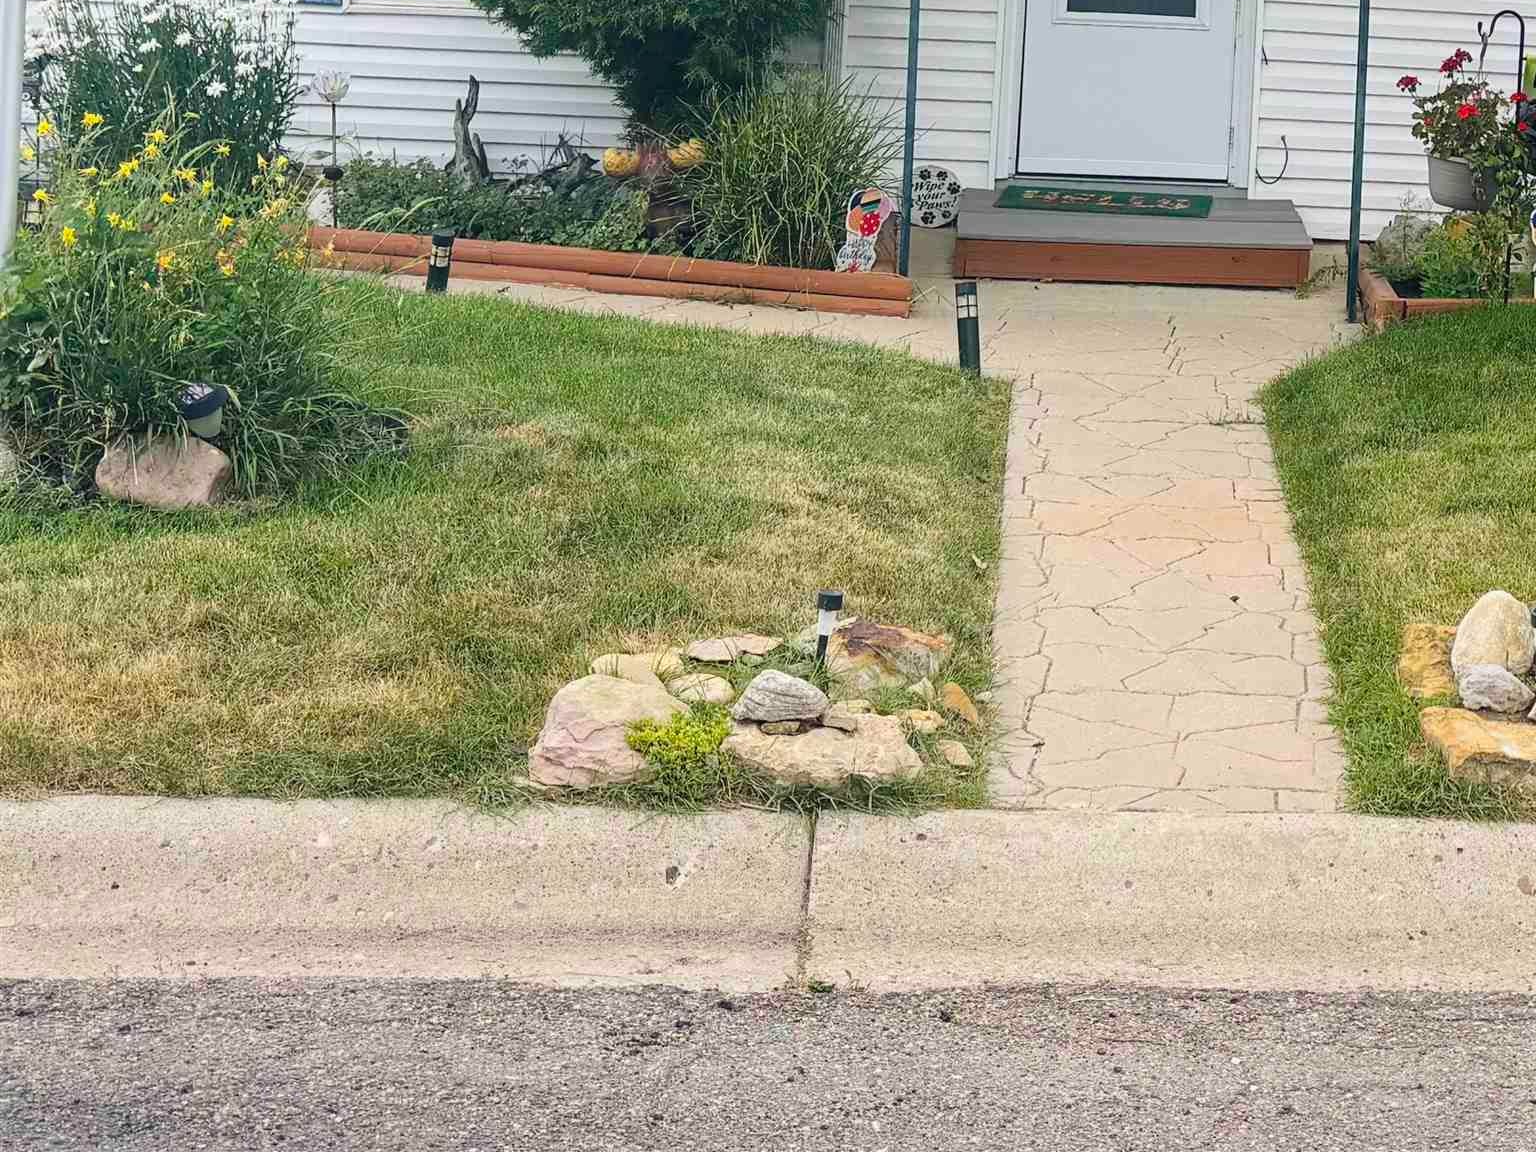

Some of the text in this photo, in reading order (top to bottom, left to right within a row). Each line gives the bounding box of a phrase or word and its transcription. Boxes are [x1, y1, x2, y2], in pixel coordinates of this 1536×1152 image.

[913, 180, 945, 194] Wipe
[914, 196, 958, 211] Paws!
[916, 192, 946, 202] your
